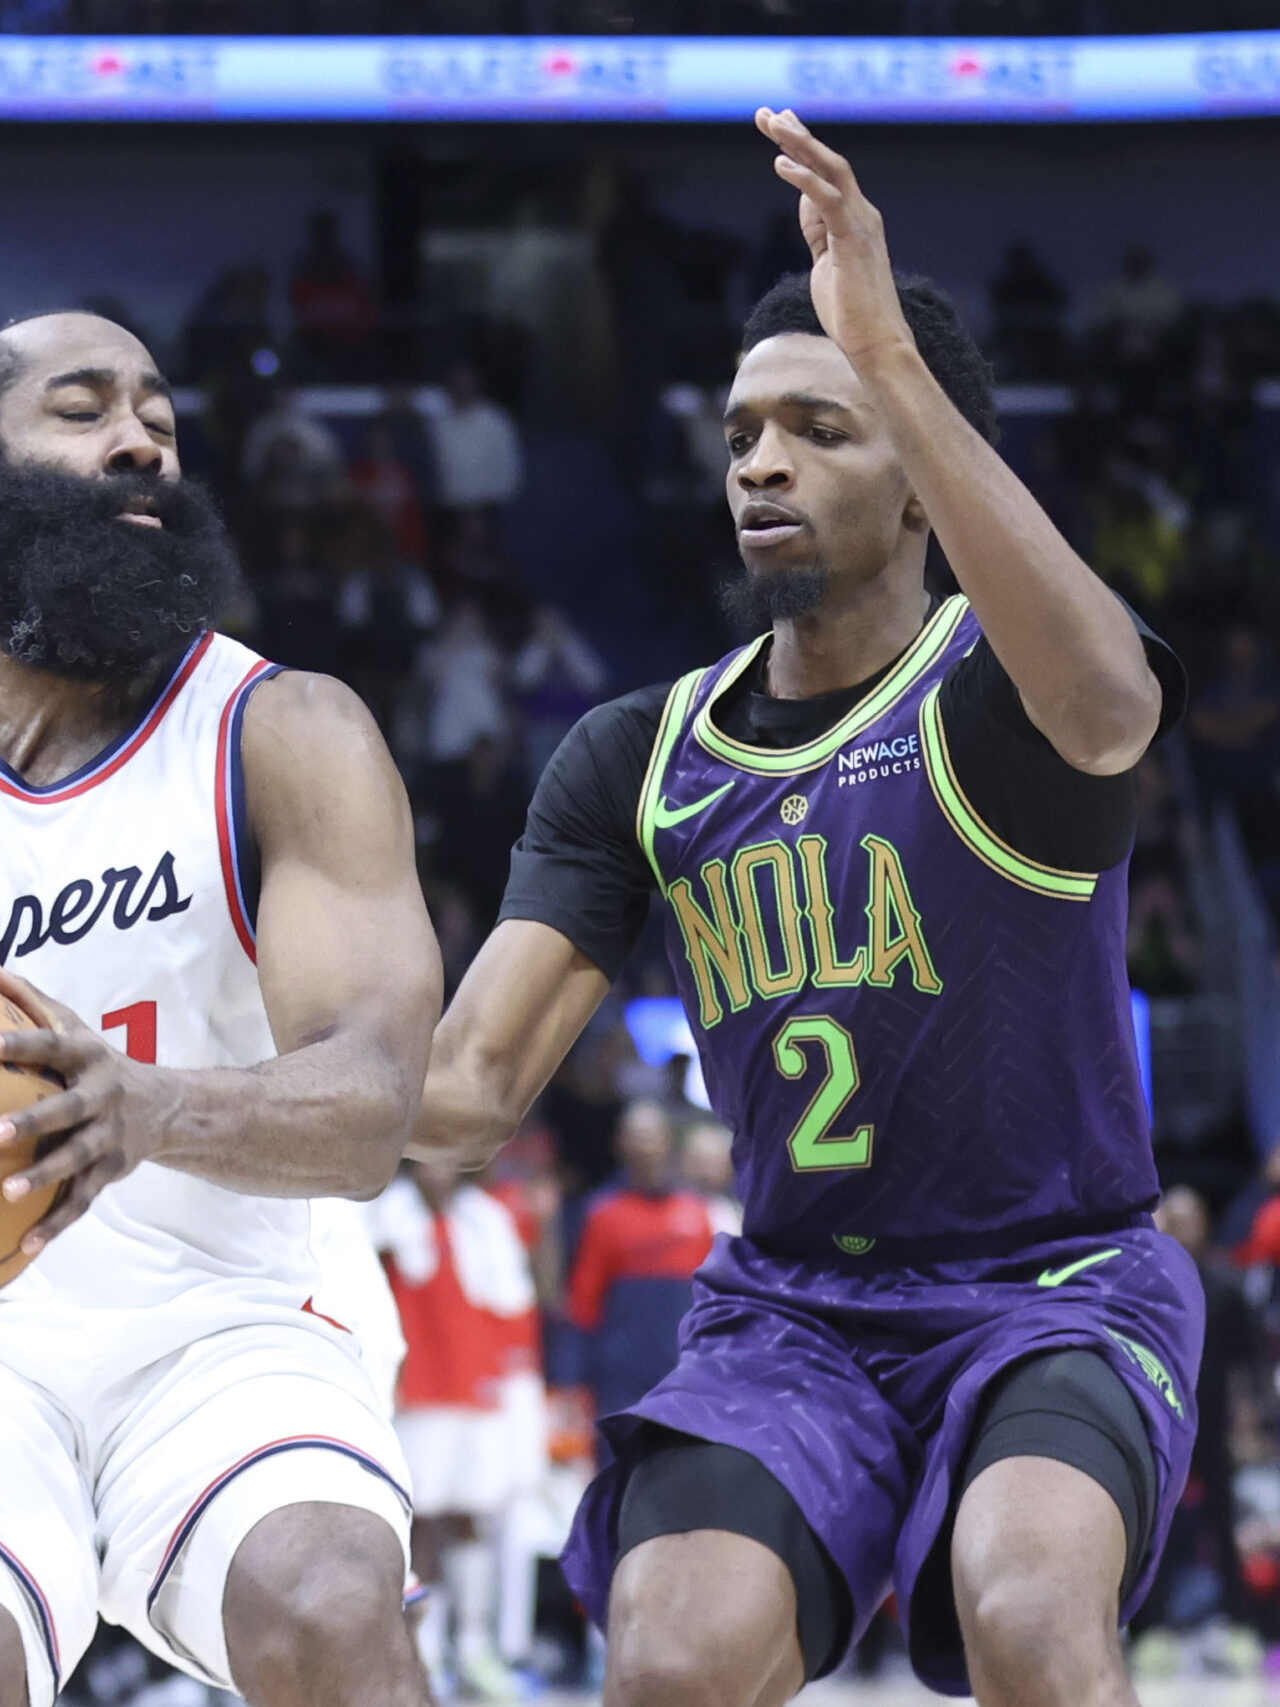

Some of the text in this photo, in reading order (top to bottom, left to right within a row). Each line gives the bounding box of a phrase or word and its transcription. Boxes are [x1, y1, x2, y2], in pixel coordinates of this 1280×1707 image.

[838, 734, 919, 772] NEWAGE
[838, 757, 921, 787] PRODUCTS
[667, 833, 943, 1030] NOLA
[101, 1000, 157, 1065] 1
[771, 1014, 874, 1173] 2
